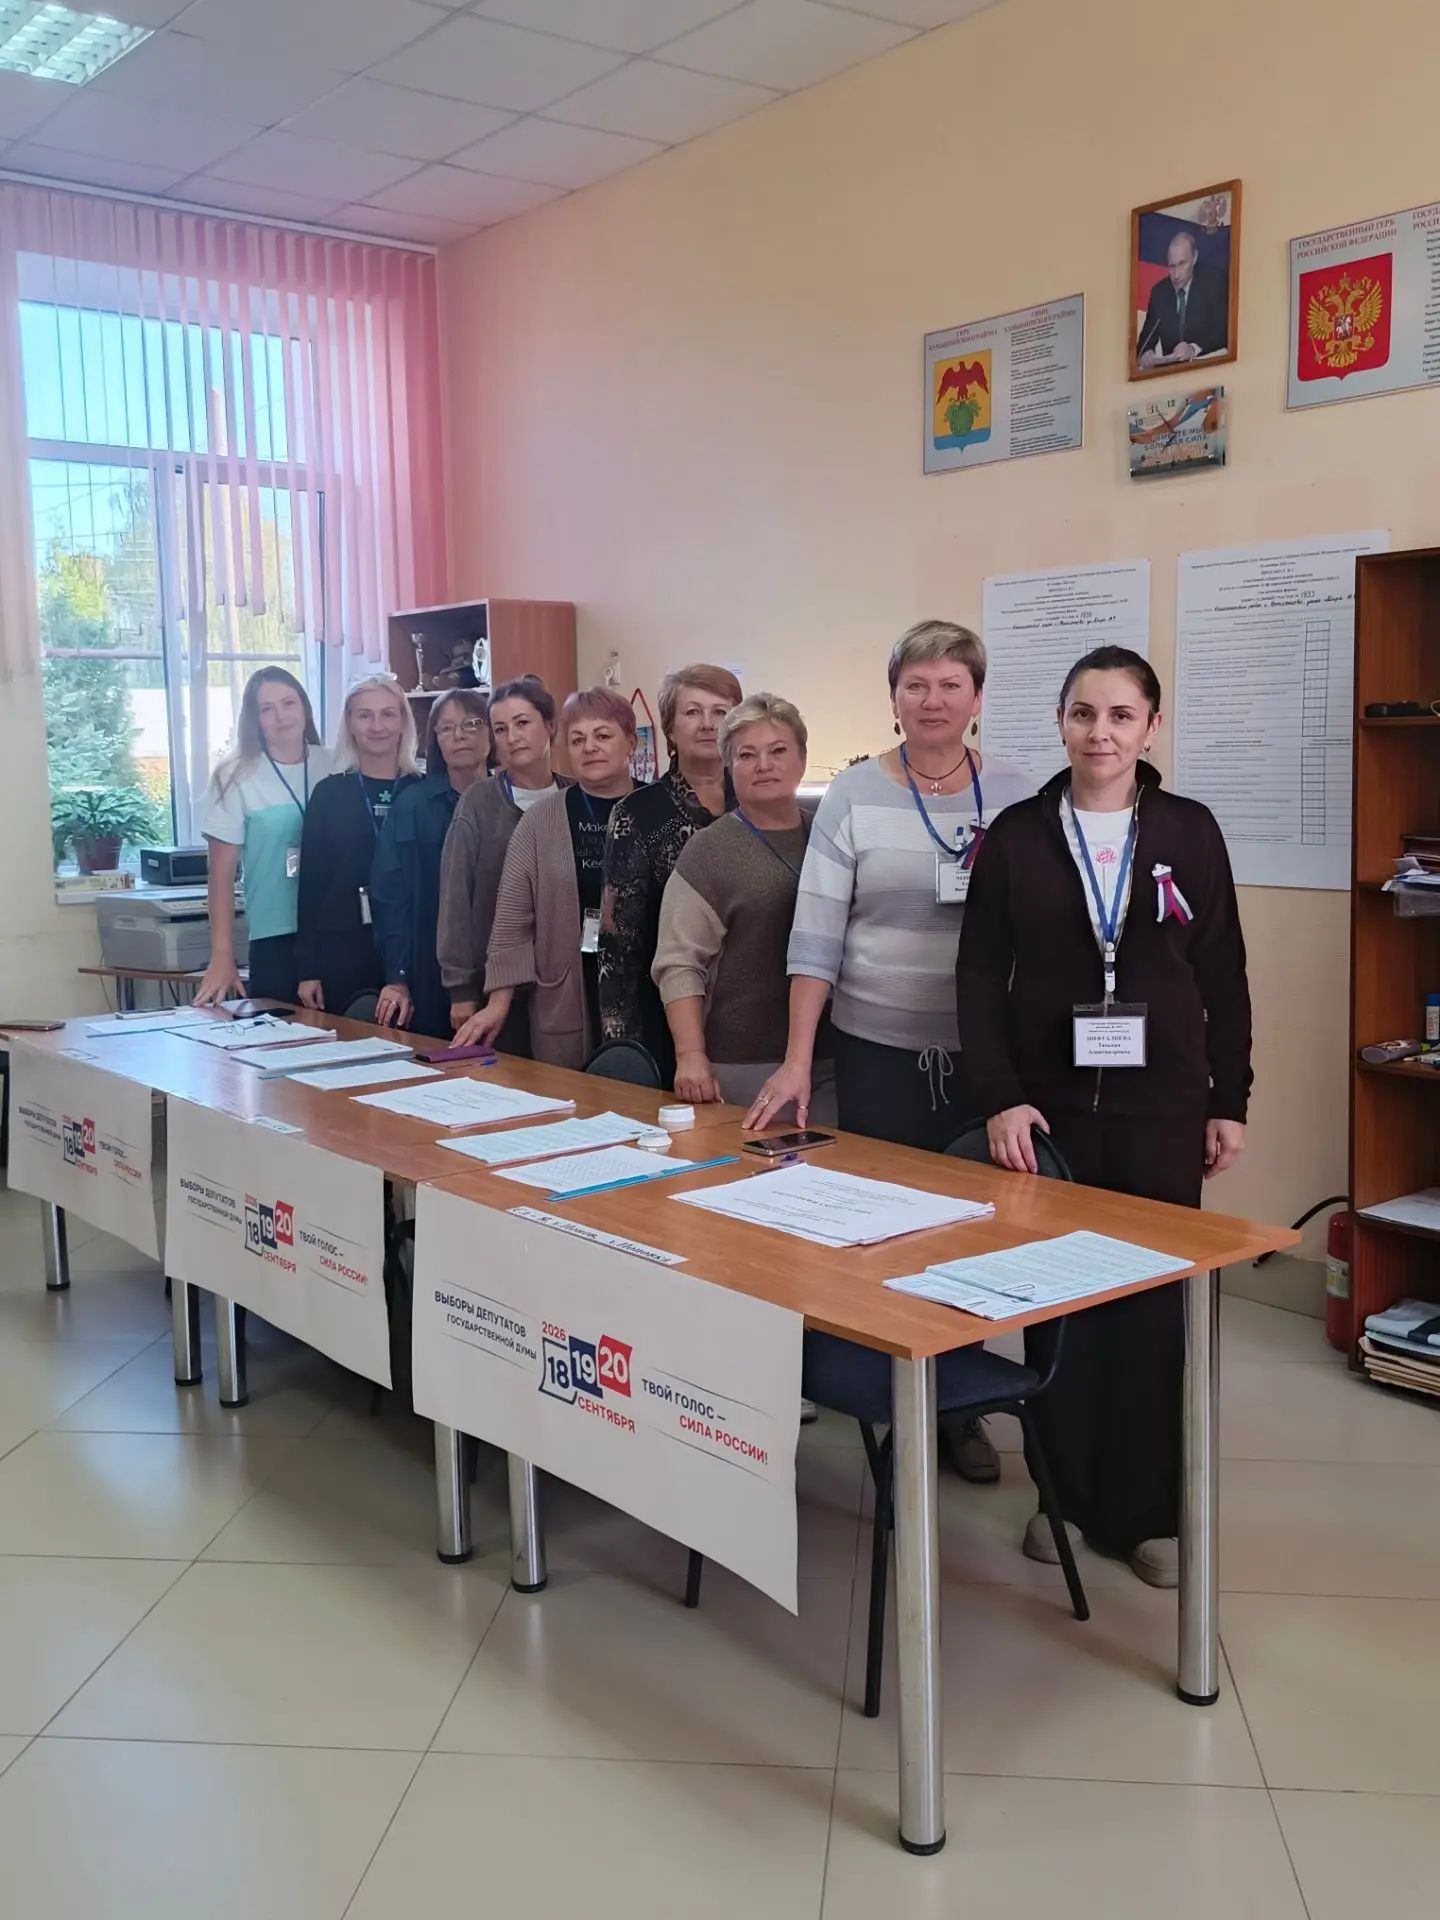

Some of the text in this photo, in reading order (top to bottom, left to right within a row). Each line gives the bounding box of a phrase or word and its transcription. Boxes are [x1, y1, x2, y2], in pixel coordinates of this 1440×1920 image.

[1296, 229, 1397, 259] РОССИЙСКОЙ ФЕДЕРАЦИИ
[1298, 219, 1396, 249] ГОСУДАРСТВЕННЫЙ ГЕРБ
[84, 1125, 94, 1146] 20
[180, 1178, 236, 1208] ВЫБОРЫ ДЕПУТАТОВ
[248, 1209, 292, 1245] 18 19 20
[299, 1230, 316, 1246] ТВОЙ
[317, 1240, 338, 1257] ГОЛОС
[263, 1250, 297, 1274] СЕНТЯБРЯ
[320, 1255, 368, 1285] СИЛА РОССИИ!
[434, 1290, 526, 1338] ВЫБОРЫ ДЕПУТАТОВ
[446, 1313, 537, 1360] ГОСУДАРСТВЕННОЙ ДУМЫ
[541, 1321, 566, 1342] 2026
[548, 1346, 628, 1389] 18 19 20
[641, 1378, 672, 1402] ТВОЙ
[675, 1392, 714, 1420] ГОЛОС
[577, 1396, 636, 1434] СЕНТЯБРЯ
[680, 1415, 768, 1465] СИЛА РОССИИ!
